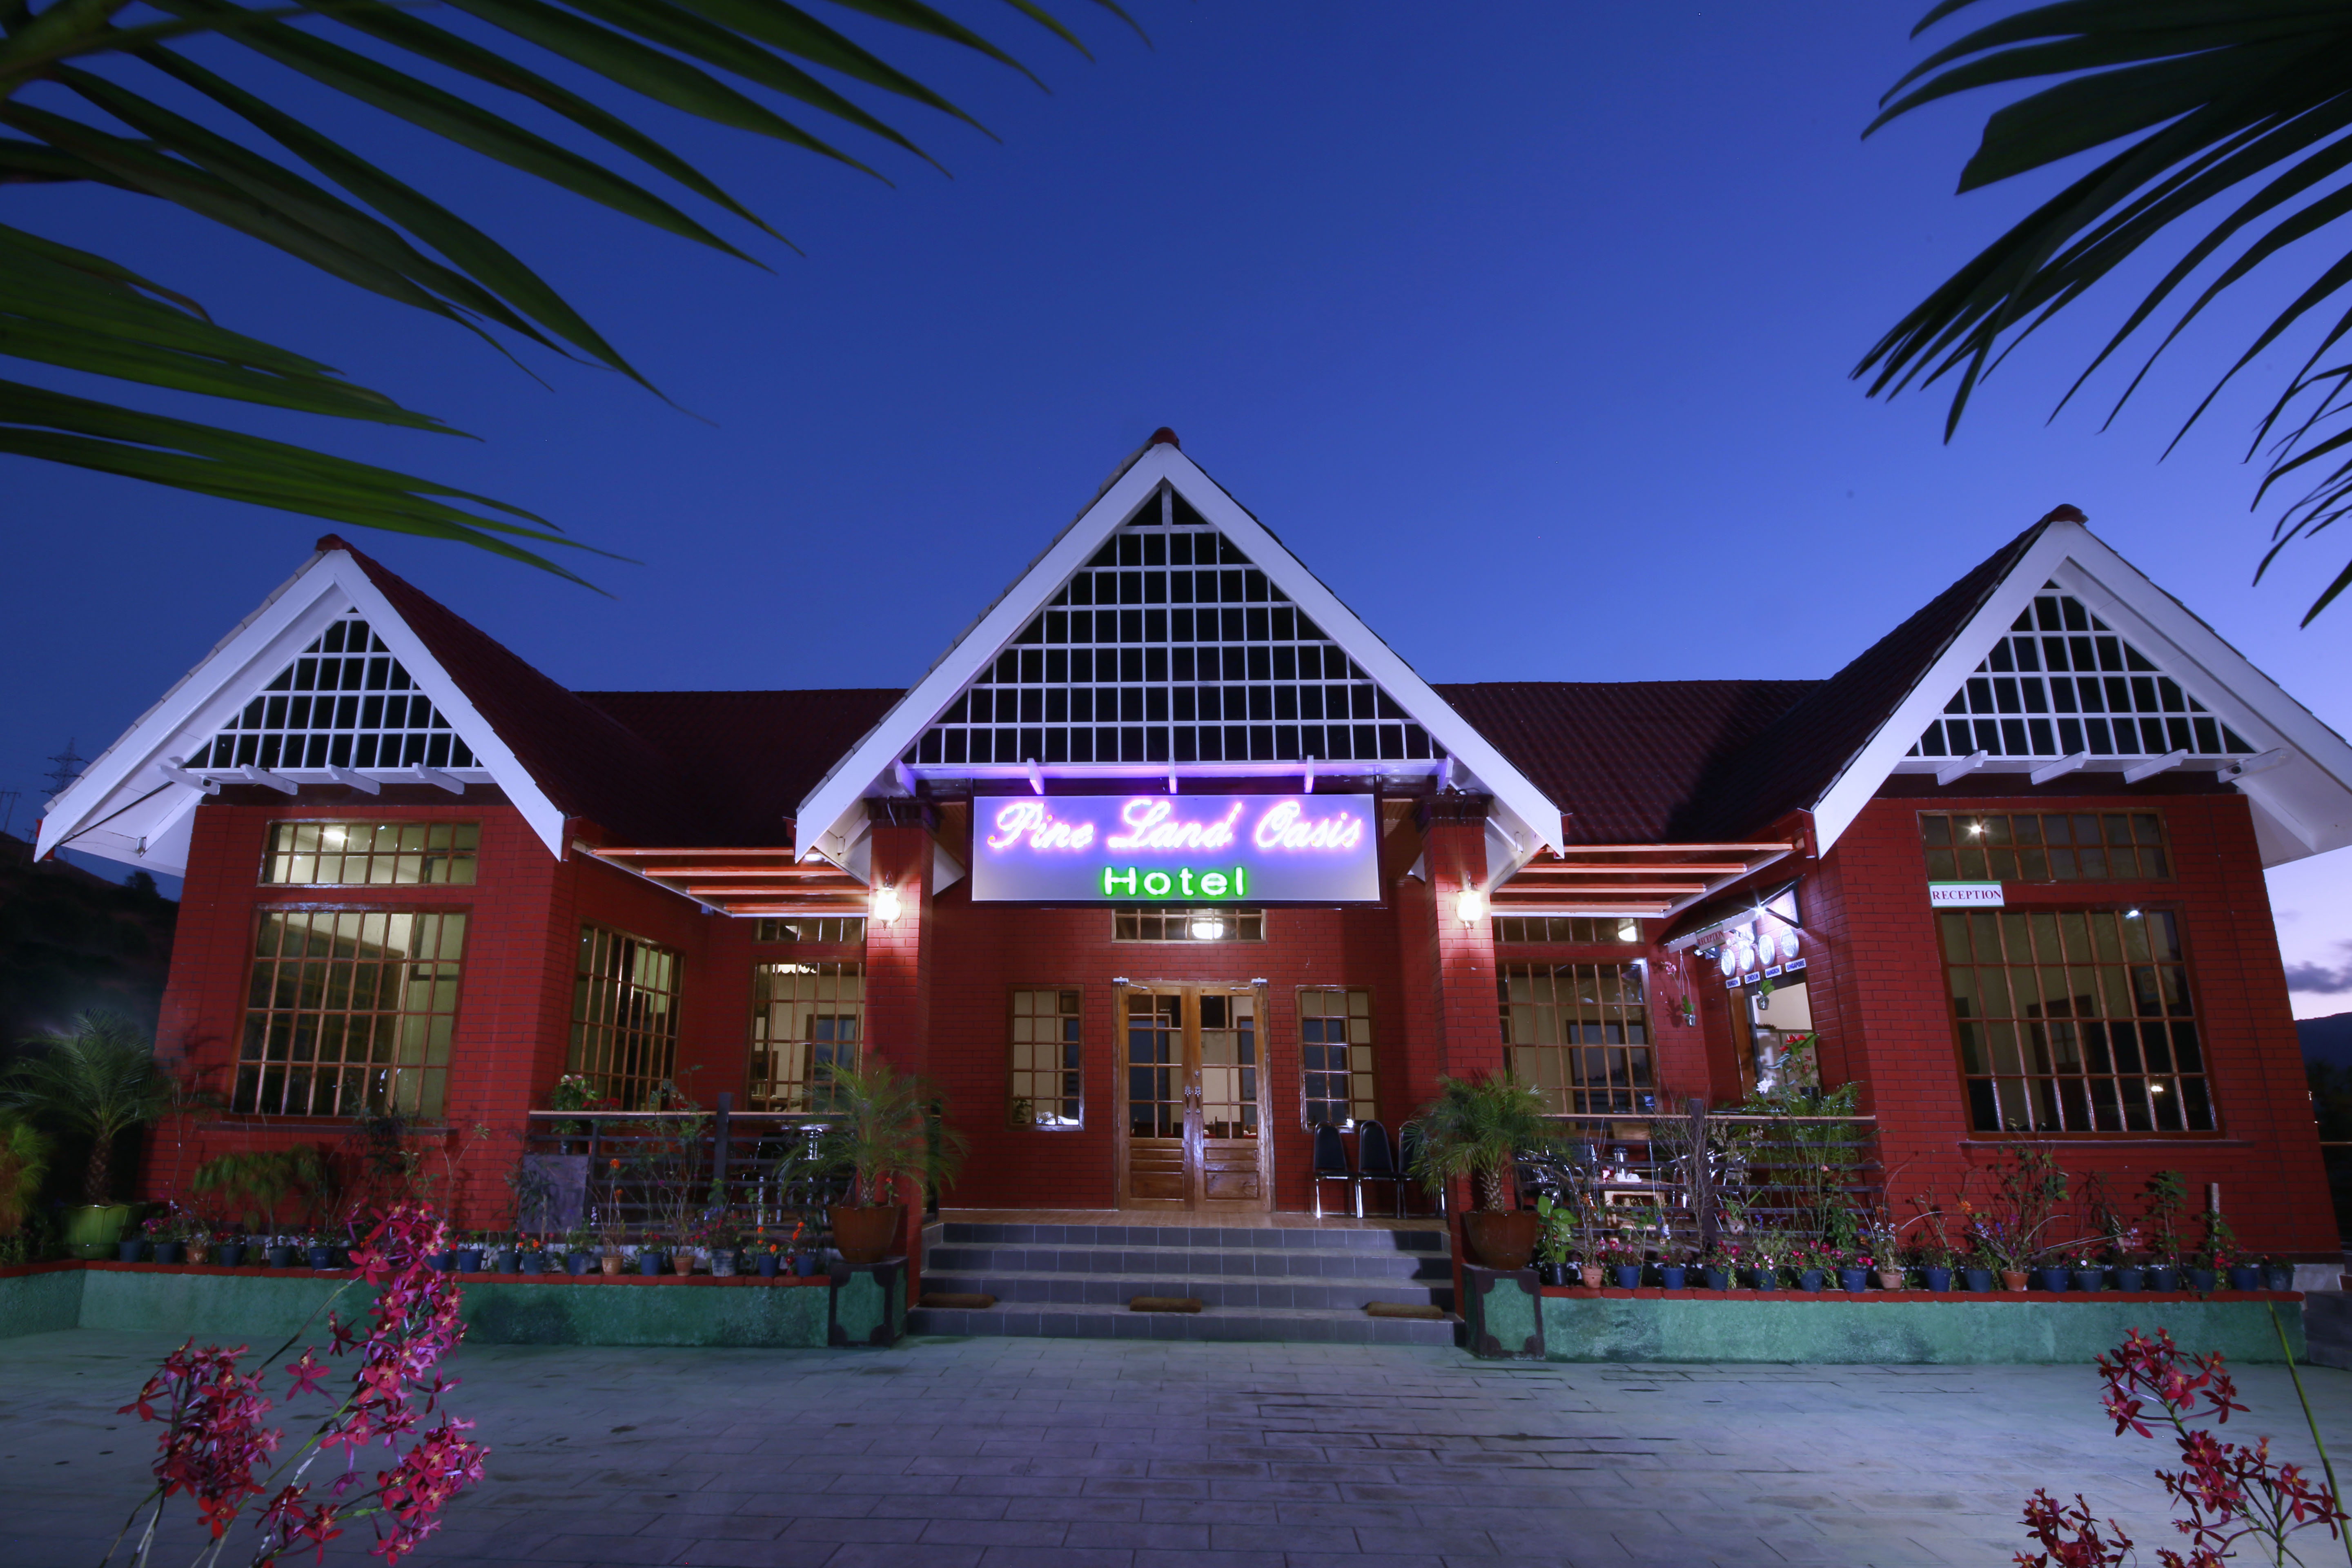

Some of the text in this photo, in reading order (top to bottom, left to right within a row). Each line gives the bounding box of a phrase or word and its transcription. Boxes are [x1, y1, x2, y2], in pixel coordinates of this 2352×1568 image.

[987, 799, 1361, 849] Pine Land Oasis
[1104, 866, 1244, 896] Hotel
[1932, 890, 2002, 900] RECEPTION
[1697, 931, 1724, 946] RECEPTION
[1786, 960, 1805, 970] SINGAPORE
[1746, 973, 1759, 982] LONDON
